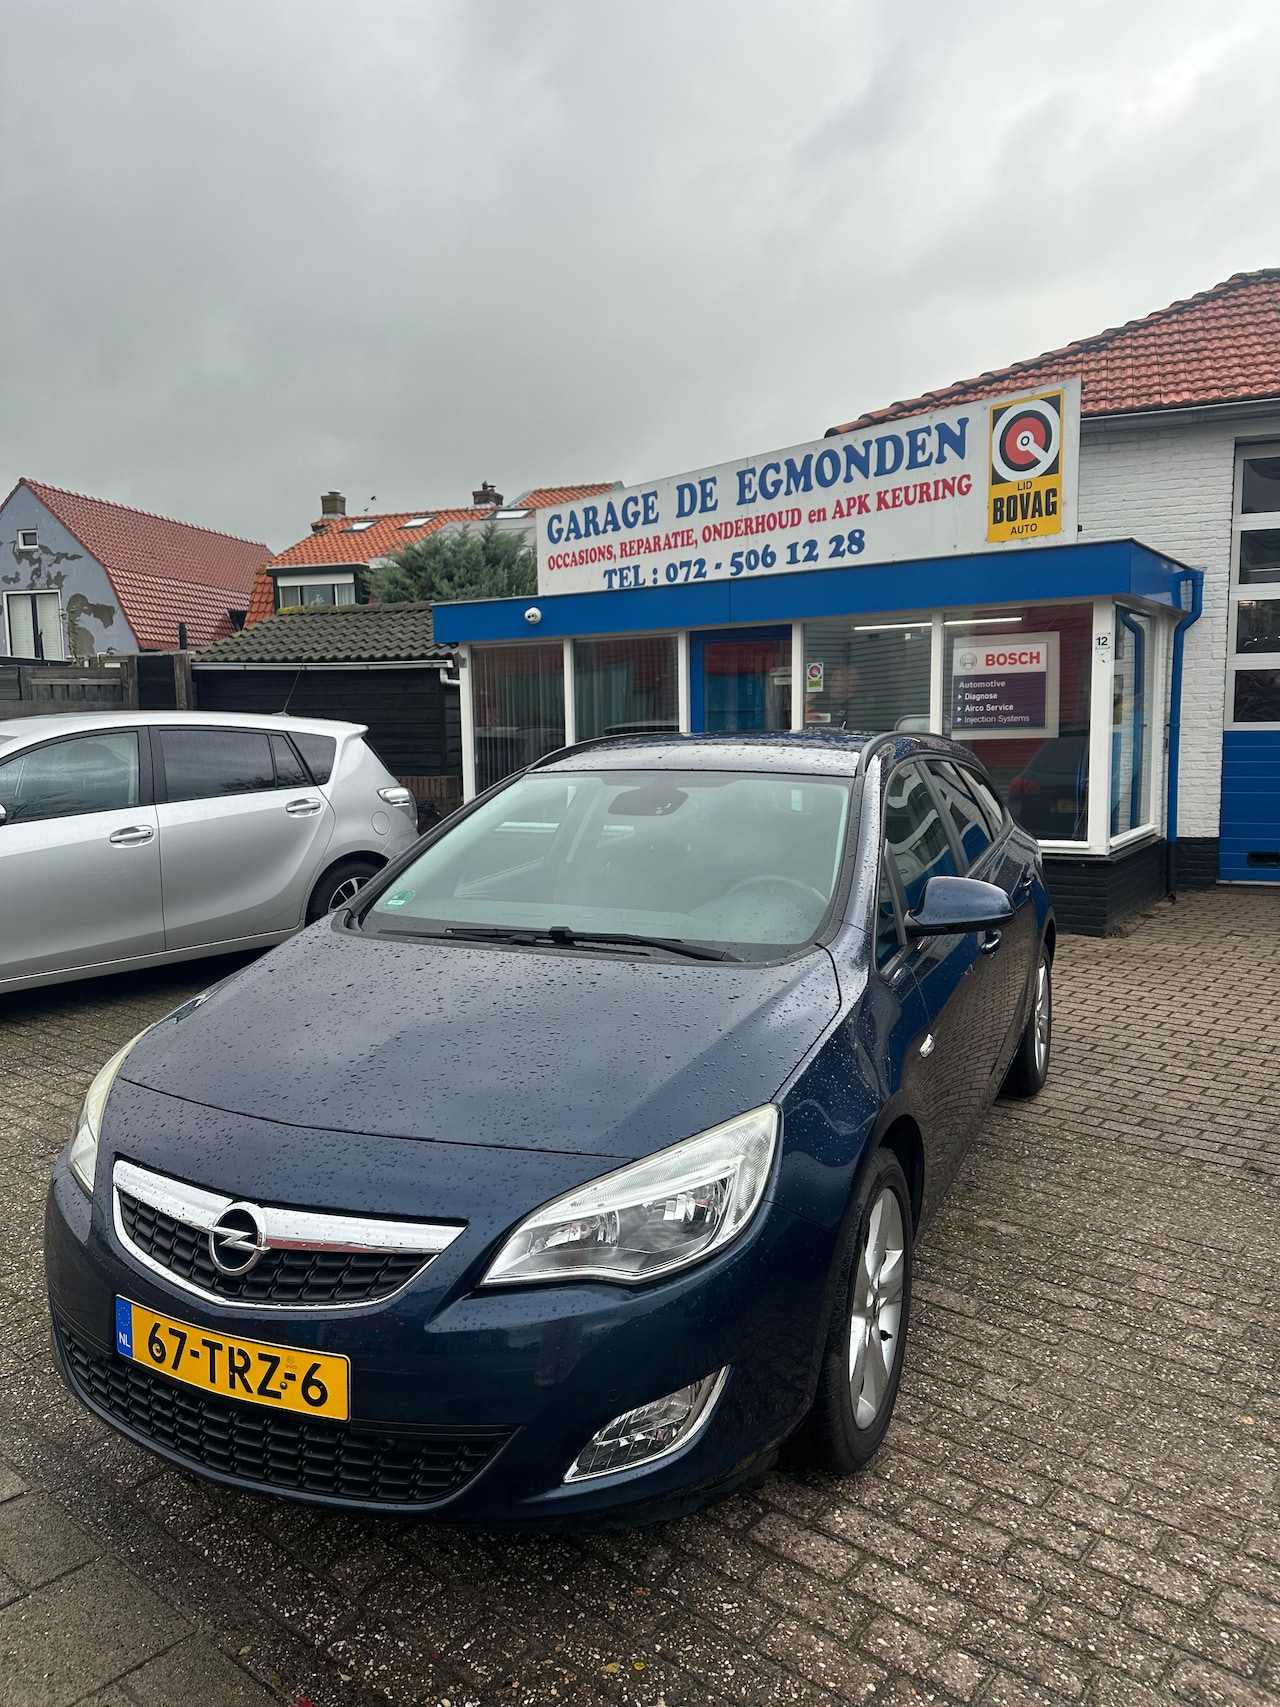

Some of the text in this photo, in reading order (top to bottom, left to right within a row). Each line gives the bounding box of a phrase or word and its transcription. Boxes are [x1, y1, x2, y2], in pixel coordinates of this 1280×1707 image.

[547, 417, 969, 544] GARAGE DE EGMONDEN
[1017, 480, 1033, 491] LID
[992, 487, 1058, 525] BOVAG
[547, 474, 973, 571] OCCASIONS, REPARATIE, ONDERHOUD en APK KEURING
[1010, 523, 1038, 535] AUTO
[665, 557, 707, 582] 072
[730, 544, 777, 576] 506
[786, 539, 819, 564] 12
[828, 529, 865, 558] 28
[1095, 636, 1108, 646] 12
[985, 652, 1040, 666] BOSCH
[959, 680, 1006, 688] Automotive
[964, 692, 997, 701] Diagnose
[964, 702, 1013, 712] Airco Service
[964, 715, 1030, 724] Injection Systems
[118, 1322, 328, 1407] NL 67-TRZ-6
